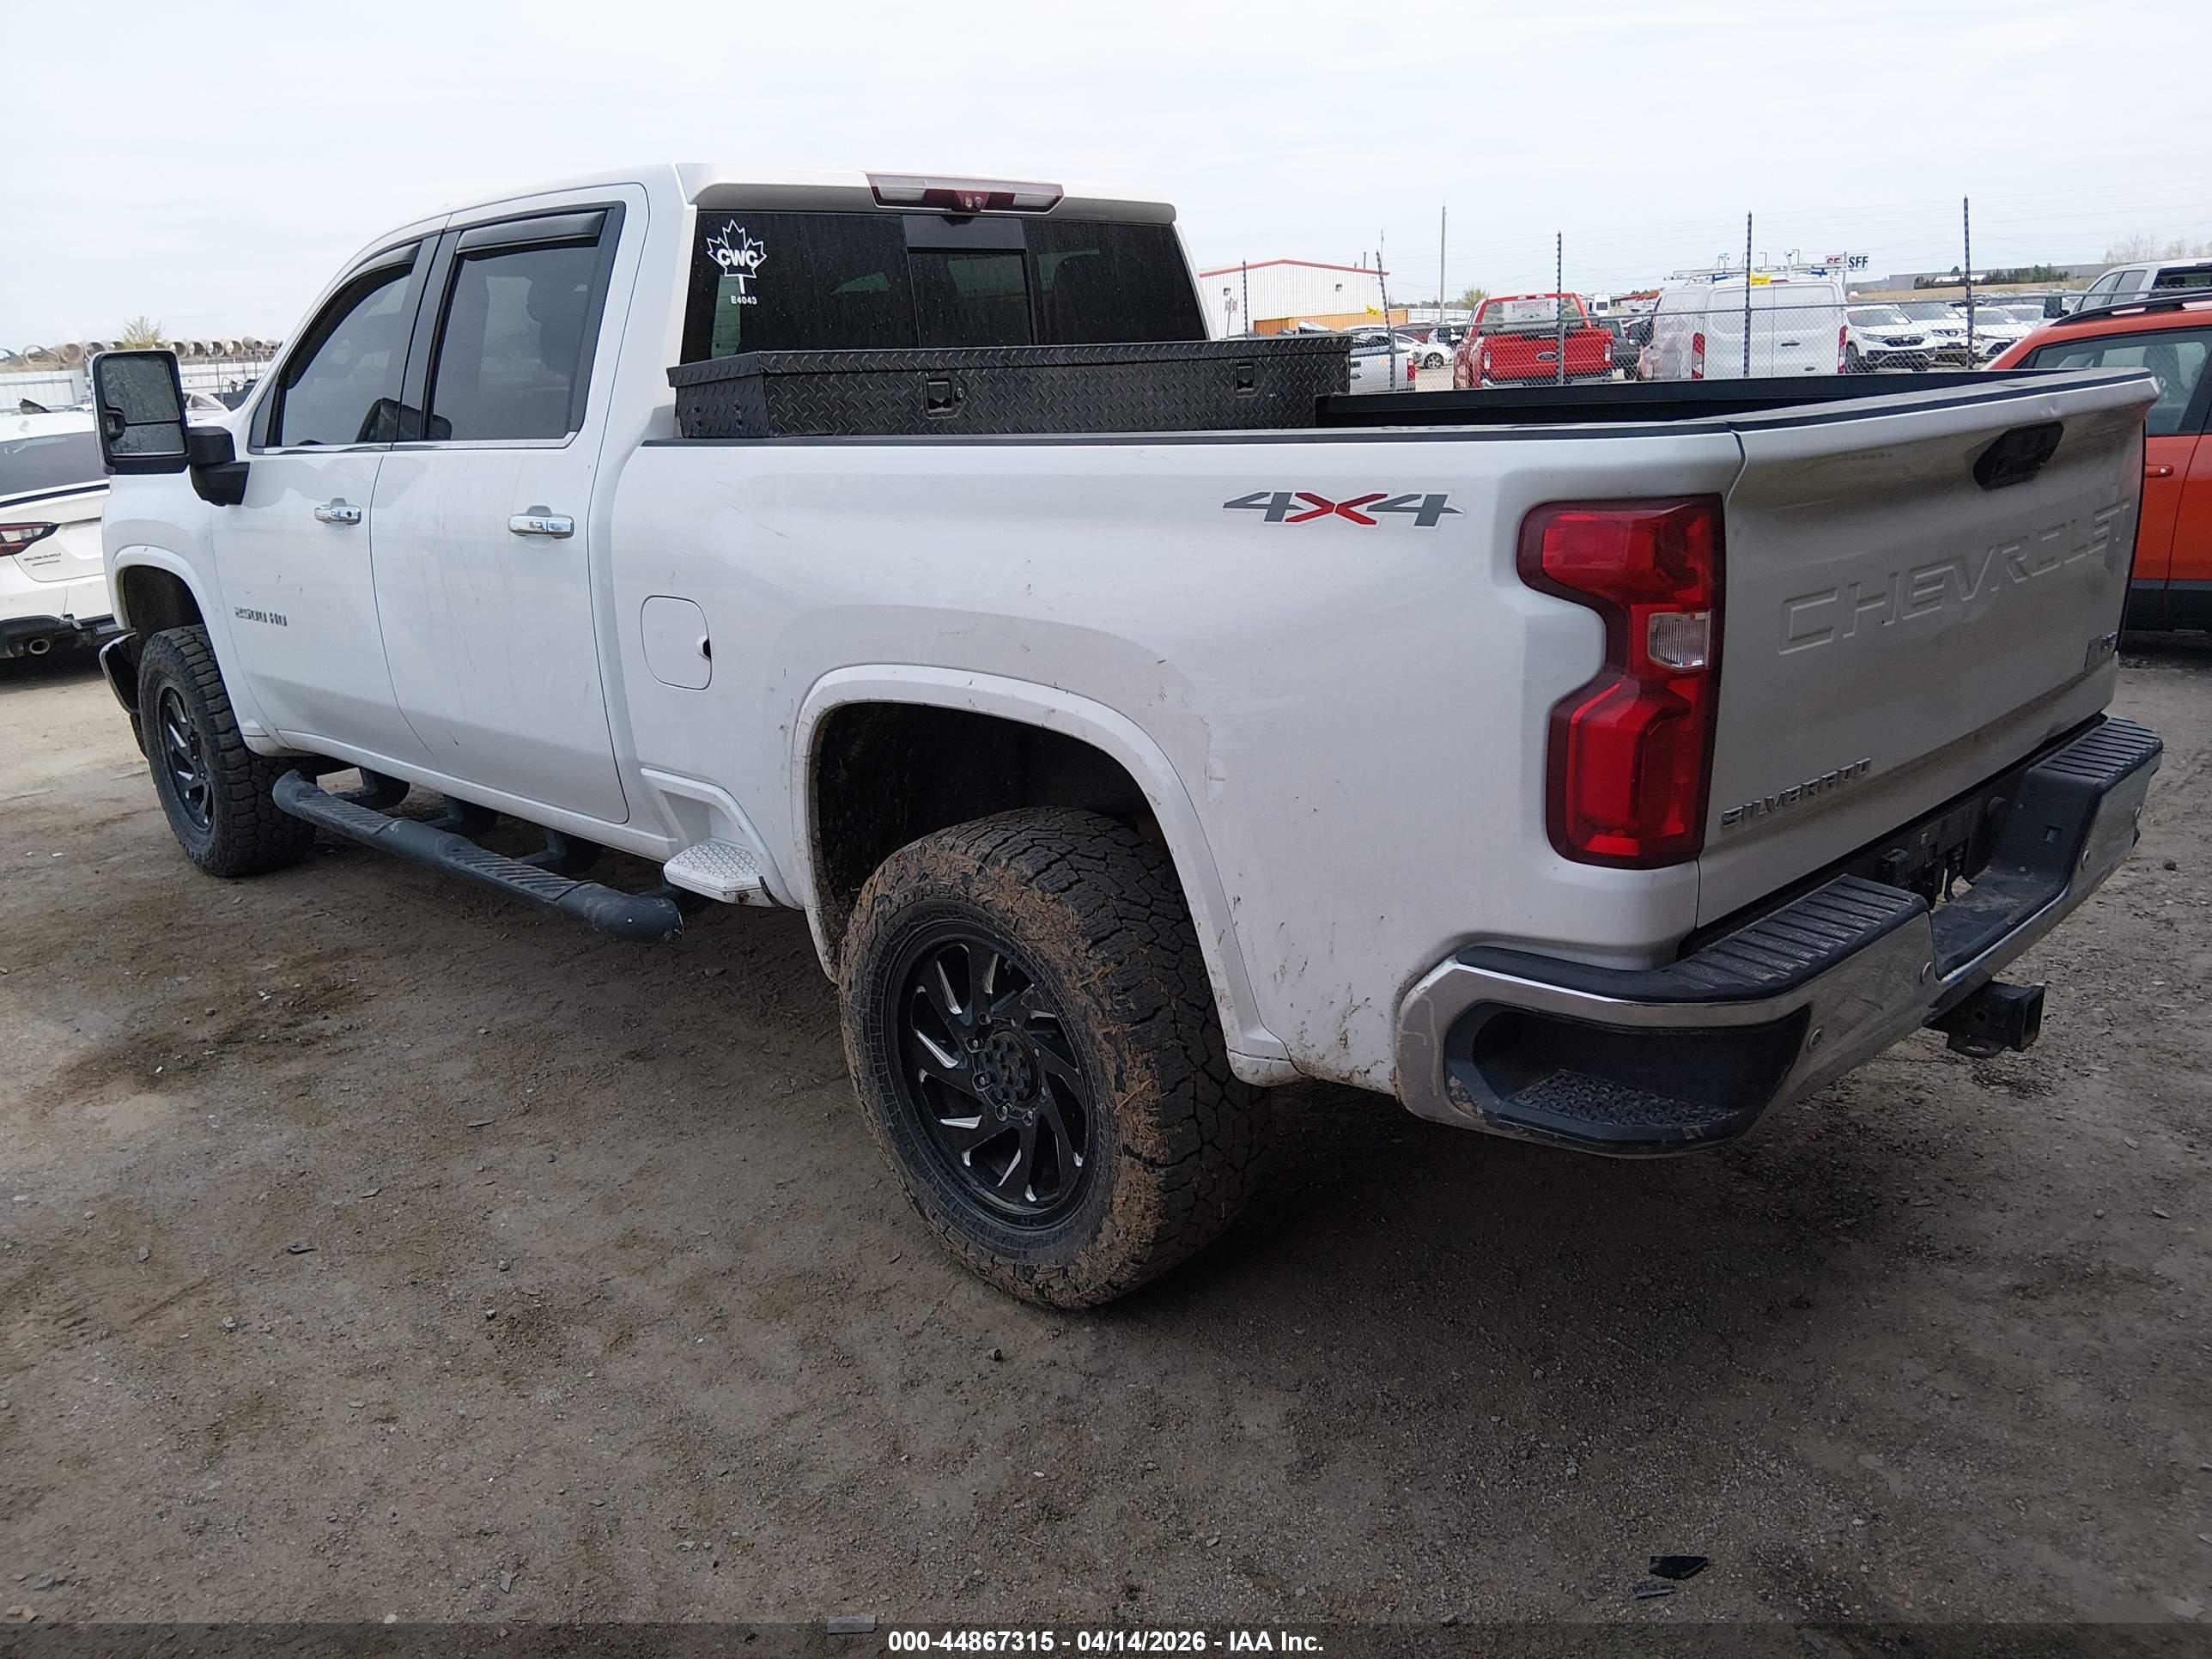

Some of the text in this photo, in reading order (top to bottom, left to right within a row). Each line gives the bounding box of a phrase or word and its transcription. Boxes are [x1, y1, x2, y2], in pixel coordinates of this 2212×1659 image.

[716, 248, 759, 267] CWC
[1848, 256, 1869, 268] SFF
[731, 295, 757, 305] E4043
[1720, 757, 1871, 830] SILVERADO
